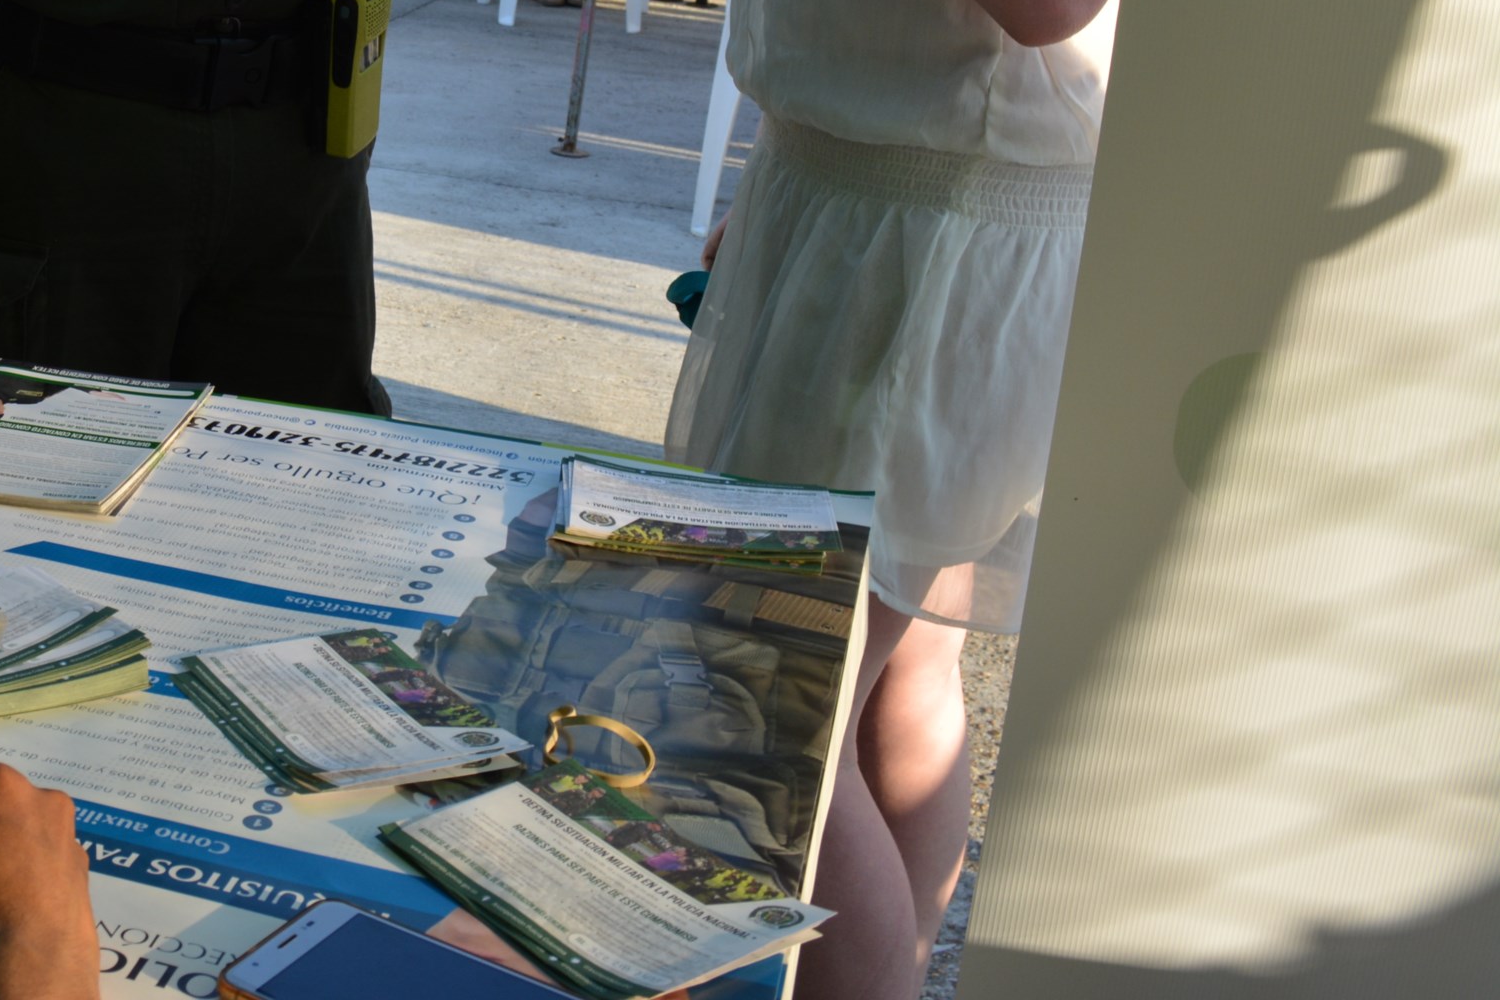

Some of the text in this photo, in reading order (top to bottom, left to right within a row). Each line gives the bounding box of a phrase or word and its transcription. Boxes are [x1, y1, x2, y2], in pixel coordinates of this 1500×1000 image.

[324, 422, 377, 438] Colombia
[216, 453, 265, 467] ser
[273, 461, 387, 489] orgullo
[459, 479, 505, 492] Mayor
[205, 528, 261, 543] mensual
[355, 529, 405, 543] servicio
[127, 544, 174, 560] policial
[263, 538, 332, 558] económica
[358, 537, 423, 556] Asistencia
[175, 553, 228, 570] doctrina
[331, 563, 363, 575] para
[333, 552, 412, 573] Bonificación
[249, 569, 337, 590] conocimiento
[348, 574, 401, 589] Obtener
[339, 585, 394, 599] Adquirir
[283, 595, 393, 621] Beneficios
[142, 702, 162, 712] su
[15, 716, 35, 727] en
[116, 712, 218, 739] antecedentes
[36, 720, 128, 746] permanecer
[19, 751, 40, 762] de
[142, 743, 179, 758] hijos
[169, 739, 229, 758] servicio
[41, 755, 93, 775] menor
[182, 752, 206, 762] sin
[109, 770, 147, 784] años
[190, 769, 210, 779] de
[148, 778, 168, 790] 18
[172, 782, 193, 794] de
[27, 770, 236, 824] Colombiano de nacimiento
[195, 788, 247, 806] Mayor
[153, 826, 231, 856] Como
[521, 797, 751, 939] DEFINA SU SITUACIÓN MILITAR EN LA POLICÍA NACIONAL
[512, 823, 551, 850] RAZONES
[546, 846, 571, 863] PARA
[583, 871, 611, 891] PARTE
[620, 896, 642, 911] ESTE
[639, 909, 699, 942] COMPROMISO
